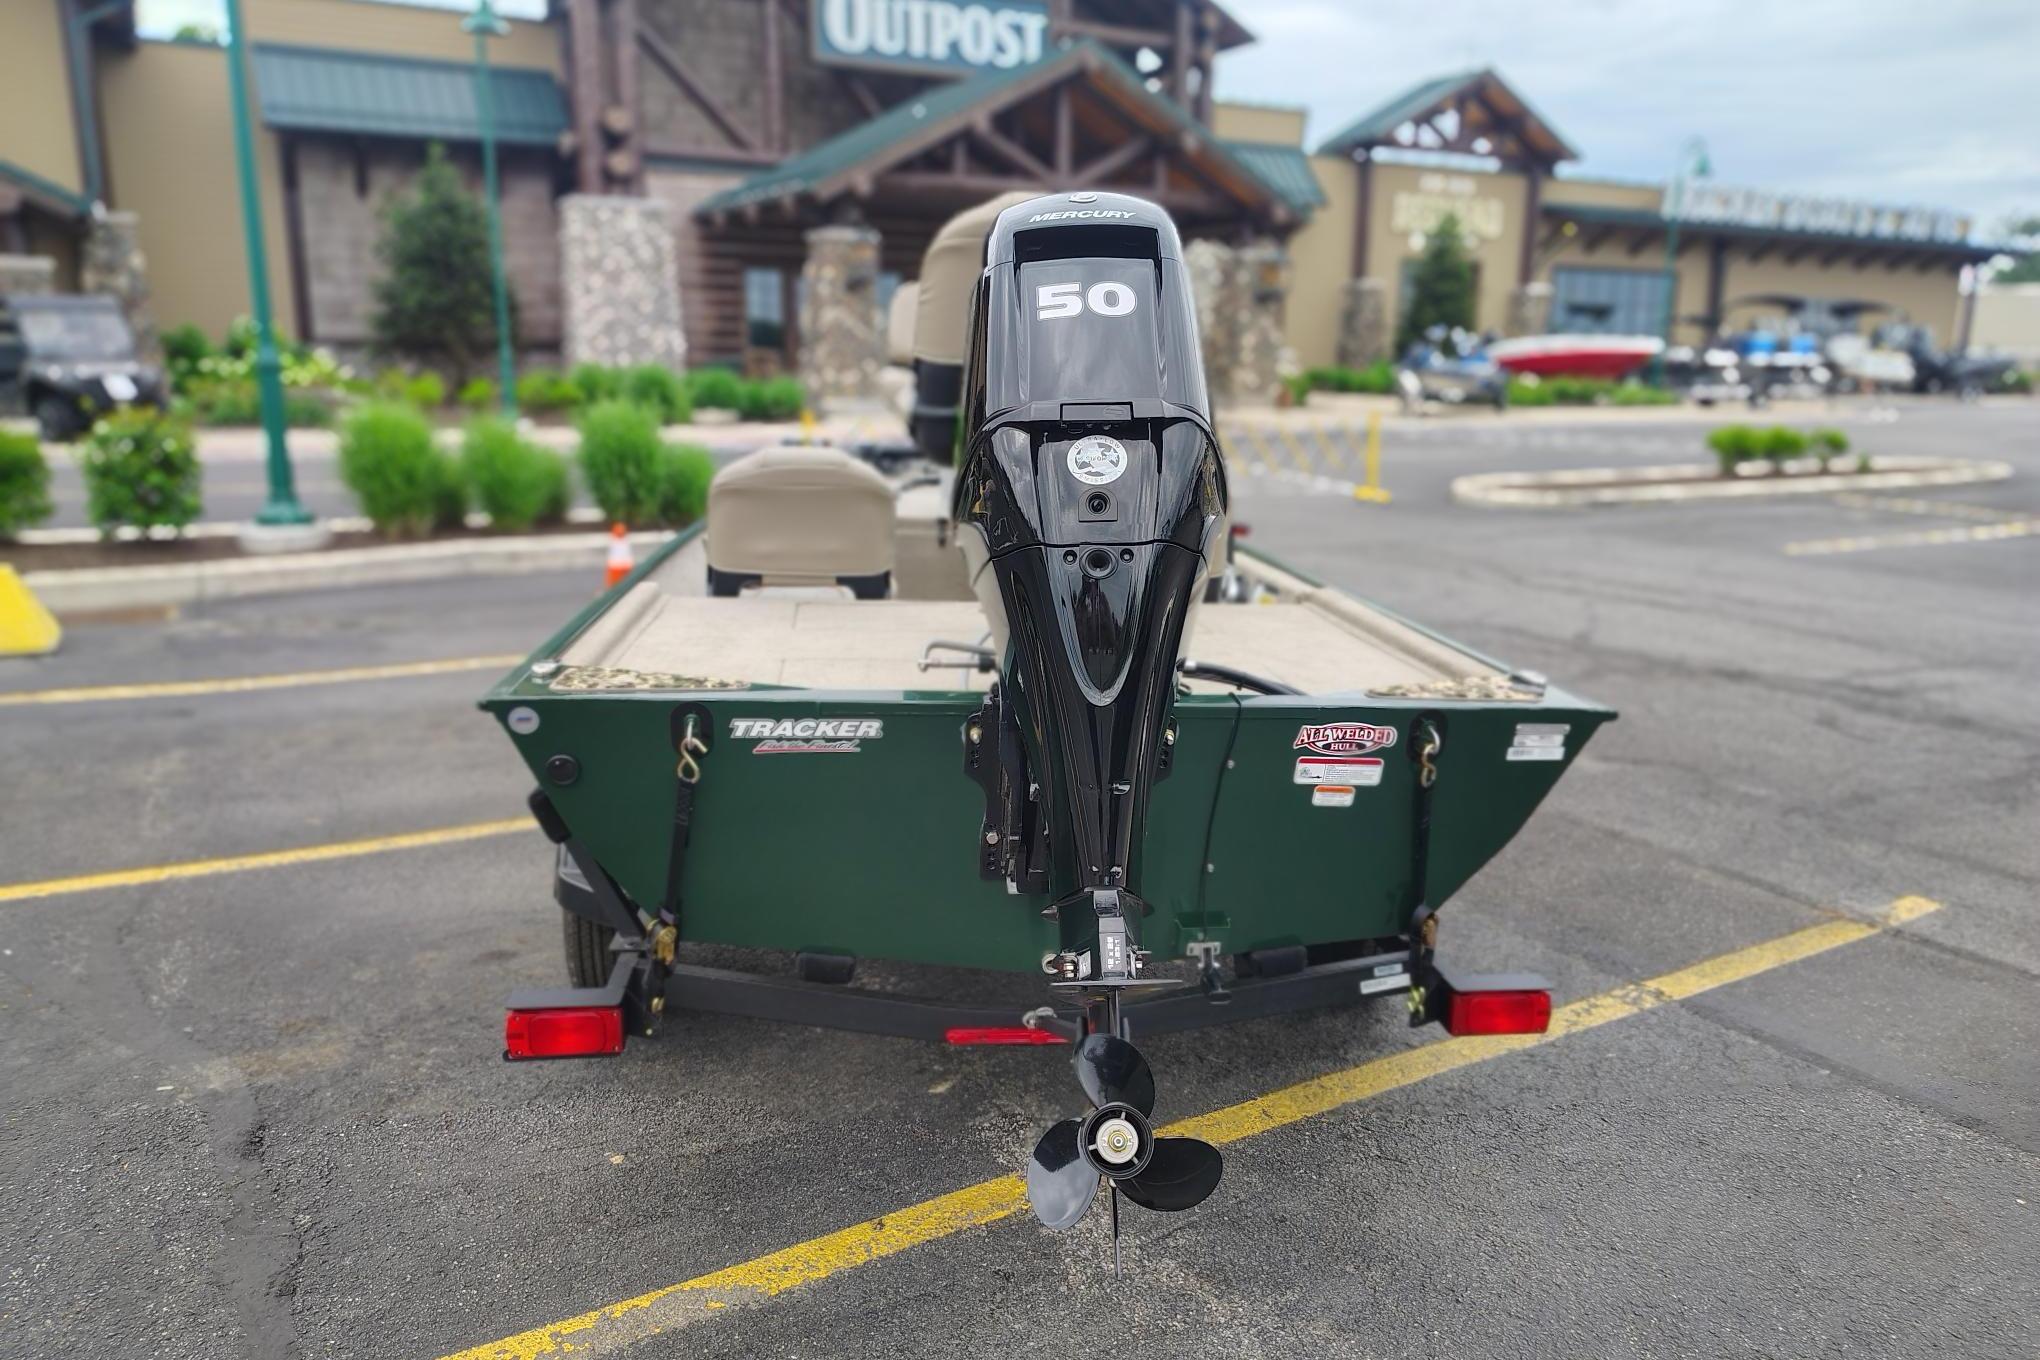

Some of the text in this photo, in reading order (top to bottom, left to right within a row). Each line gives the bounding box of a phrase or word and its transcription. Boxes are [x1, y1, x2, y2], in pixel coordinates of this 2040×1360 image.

[824, 0, 1047, 68] OUTPOST
[1029, 209, 1136, 223] MERCURY
[1036, 281, 1137, 320] 50
[730, 719, 882, 738] TRACKER
[1330, 727, 1395, 745] WELDED
[1330, 743, 1358, 751] HULL
